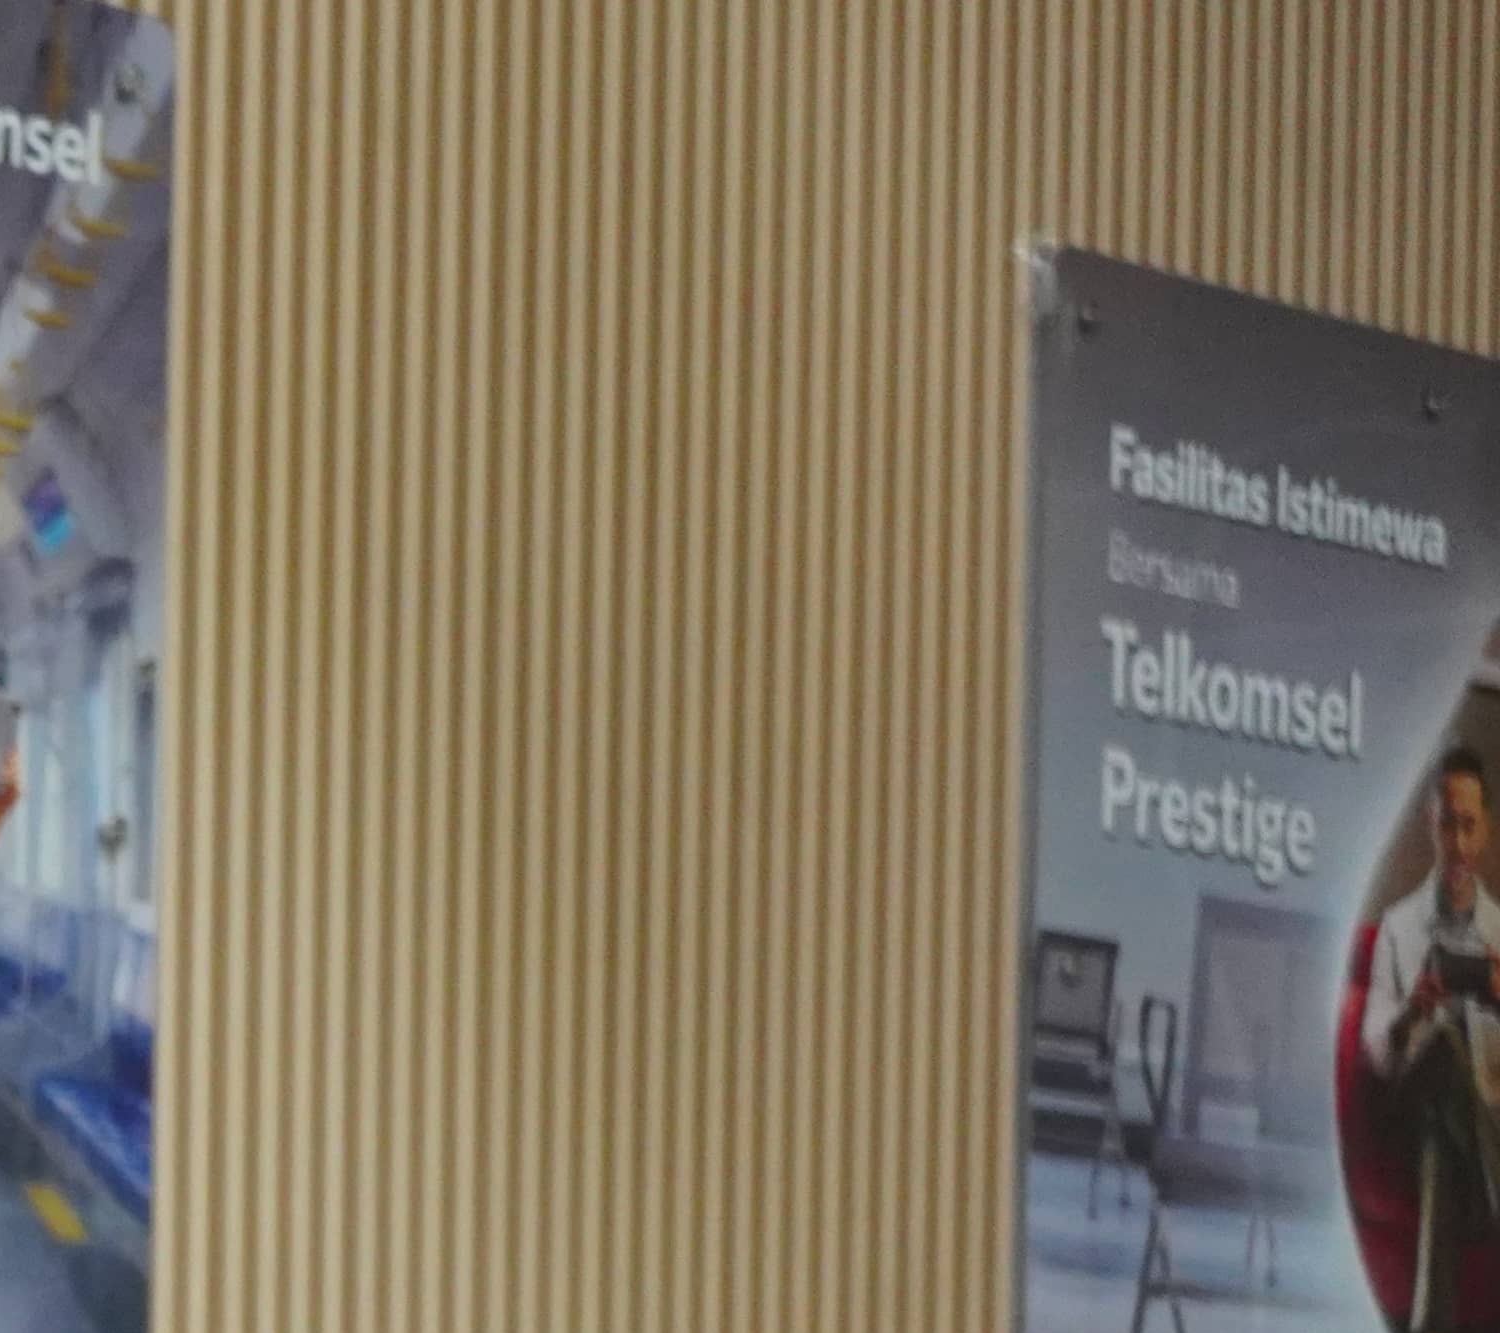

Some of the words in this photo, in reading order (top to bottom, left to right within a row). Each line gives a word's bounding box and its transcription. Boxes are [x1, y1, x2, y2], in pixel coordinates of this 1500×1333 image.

[1108, 422, 1270, 528] Fasilitas
[1276, 464, 1448, 569] Istimewa
[1101, 618, 1365, 757] Telkomsel
[1101, 746, 1318, 888] Prestige
